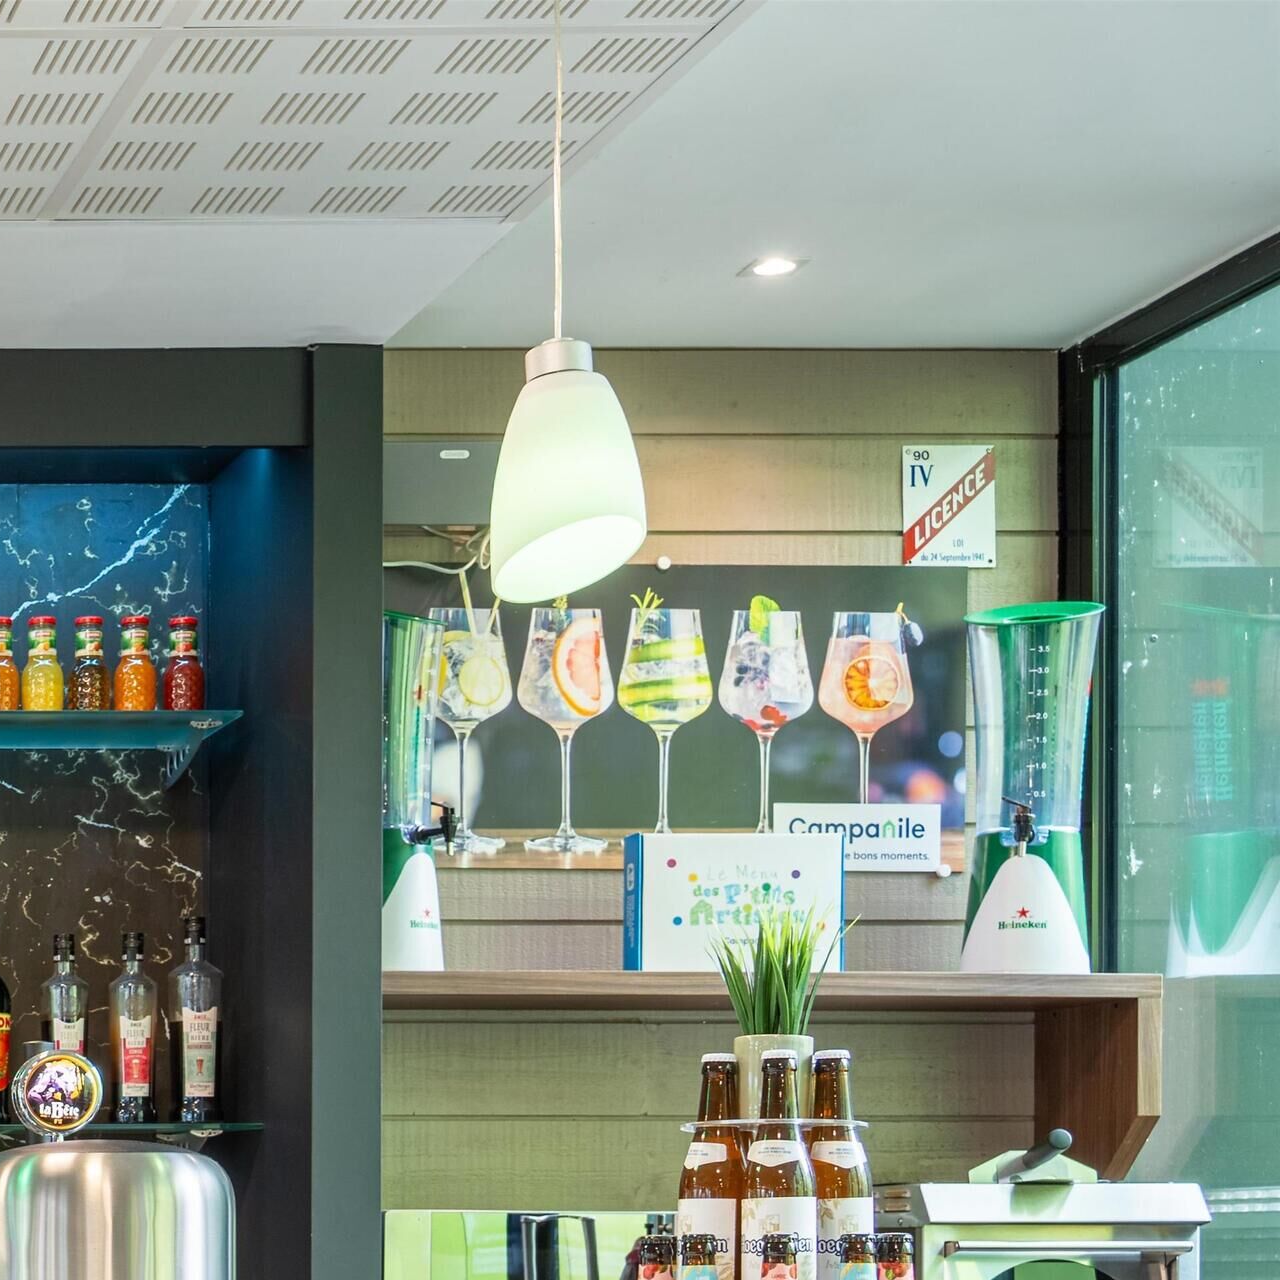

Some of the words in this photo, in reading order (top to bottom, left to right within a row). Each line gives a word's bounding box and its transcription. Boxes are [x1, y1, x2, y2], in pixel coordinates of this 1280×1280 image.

[913, 450, 930, 461] 90
[910, 464, 934, 488] IV
[914, 462, 986, 550] LICENCE
[920, 553, 929, 561] du
[931, 553, 938, 561] 24
[940, 553, 971, 563] Septembre
[972, 553, 985, 561] 1941
[1037, 645, 1050, 653] 3.5
[1036, 689, 1049, 697] 2.5
[1035, 736, 1048, 744] 1.5
[1034, 762, 1048, 770] 1.0
[1033, 790, 1047, 798] 0.5
[788, 817, 926, 844] Campanile
[853, 851, 878, 861] bons
[880, 851, 930, 861] moments.
[706, 865, 727, 881] Le
[692, 885, 720, 897] des
[997, 920, 1047, 930] Heineken
[190, 1022, 210, 1033] FLEUR
